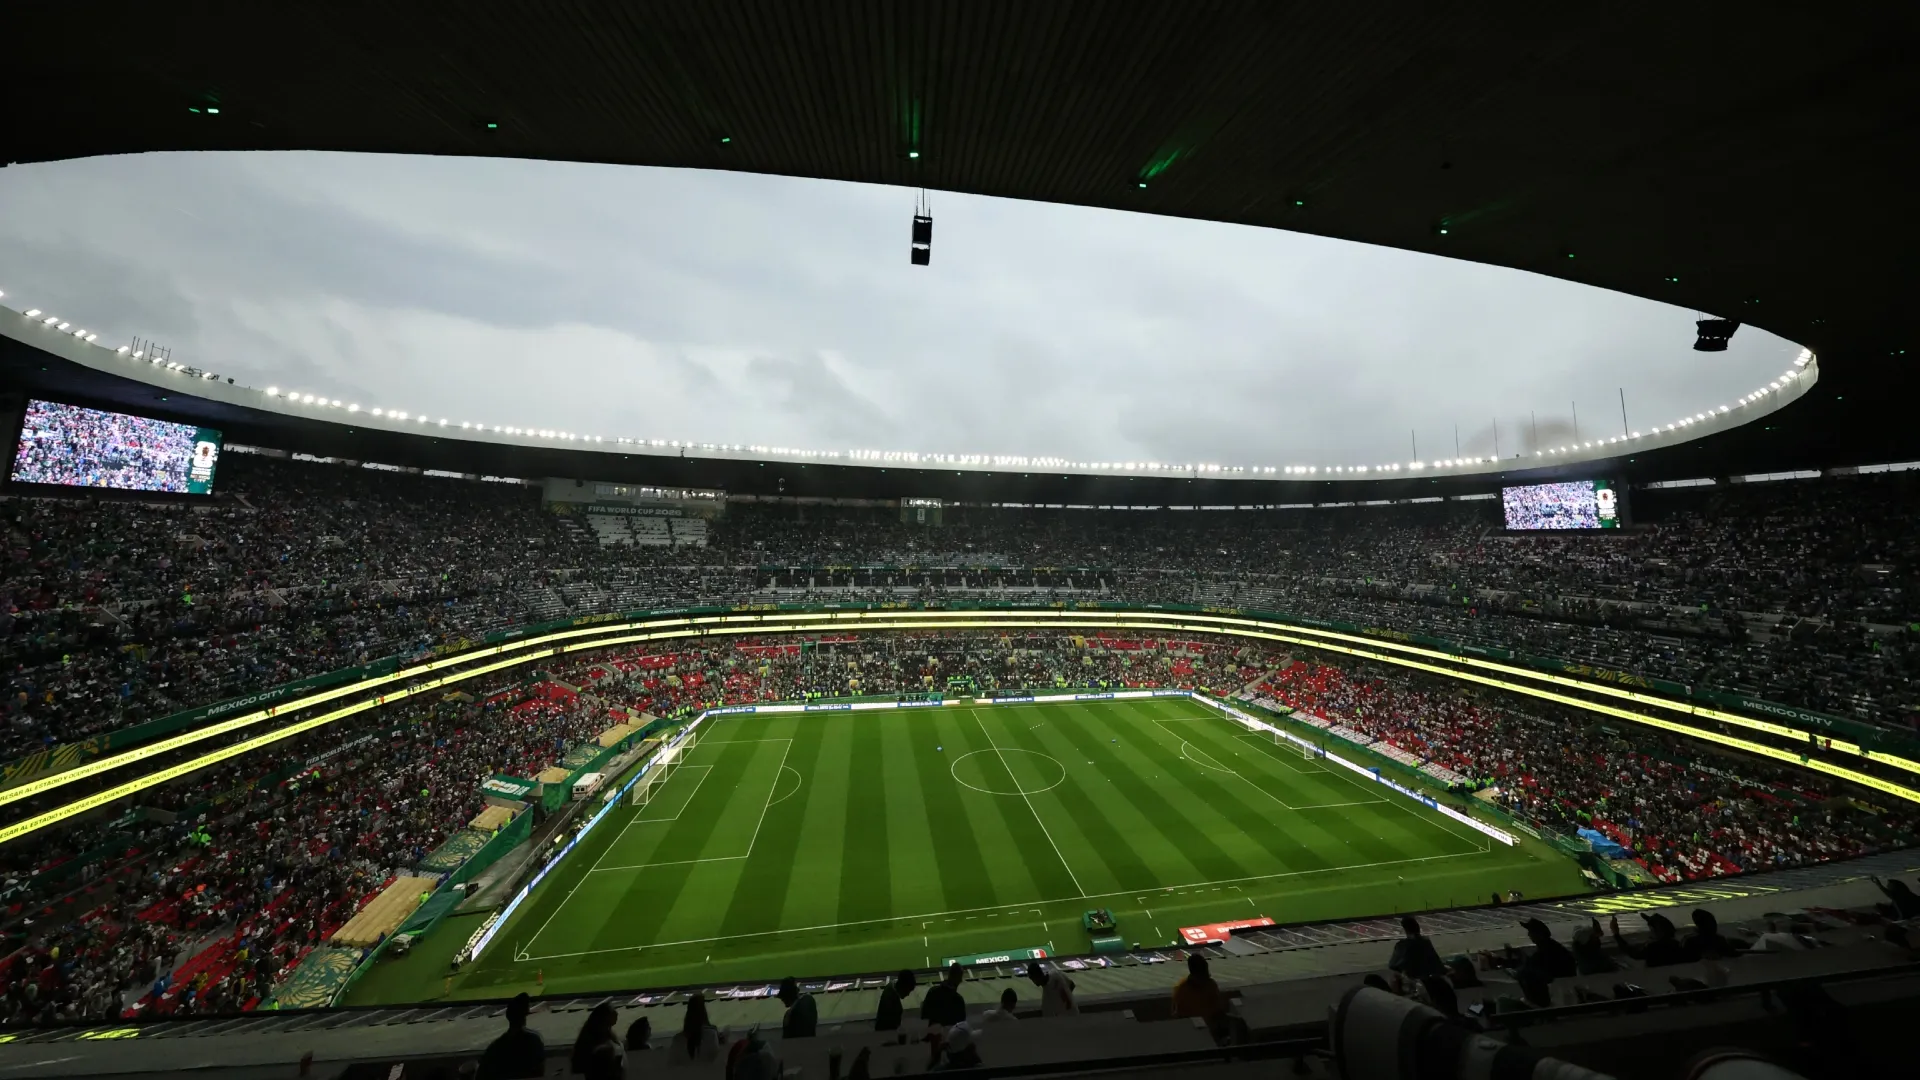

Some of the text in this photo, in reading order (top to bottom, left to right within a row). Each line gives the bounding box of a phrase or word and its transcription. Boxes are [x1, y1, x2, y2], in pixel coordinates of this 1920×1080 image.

[588, 505, 606, 513] FIFA
[207, 696, 256, 716] MEXICO
[258, 688, 285, 701] CITY
[1743, 700, 1797, 718] MEXICO
[1800, 713, 1832, 727] CITY
[35, 776, 63, 790] ESTADIO
[30, 813, 58, 828] ESTADIO
[64, 802, 90, 815] OCUPAR
[103, 787, 131, 800] ASIENTOS
[975, 955, 1010, 964] MEXICO
